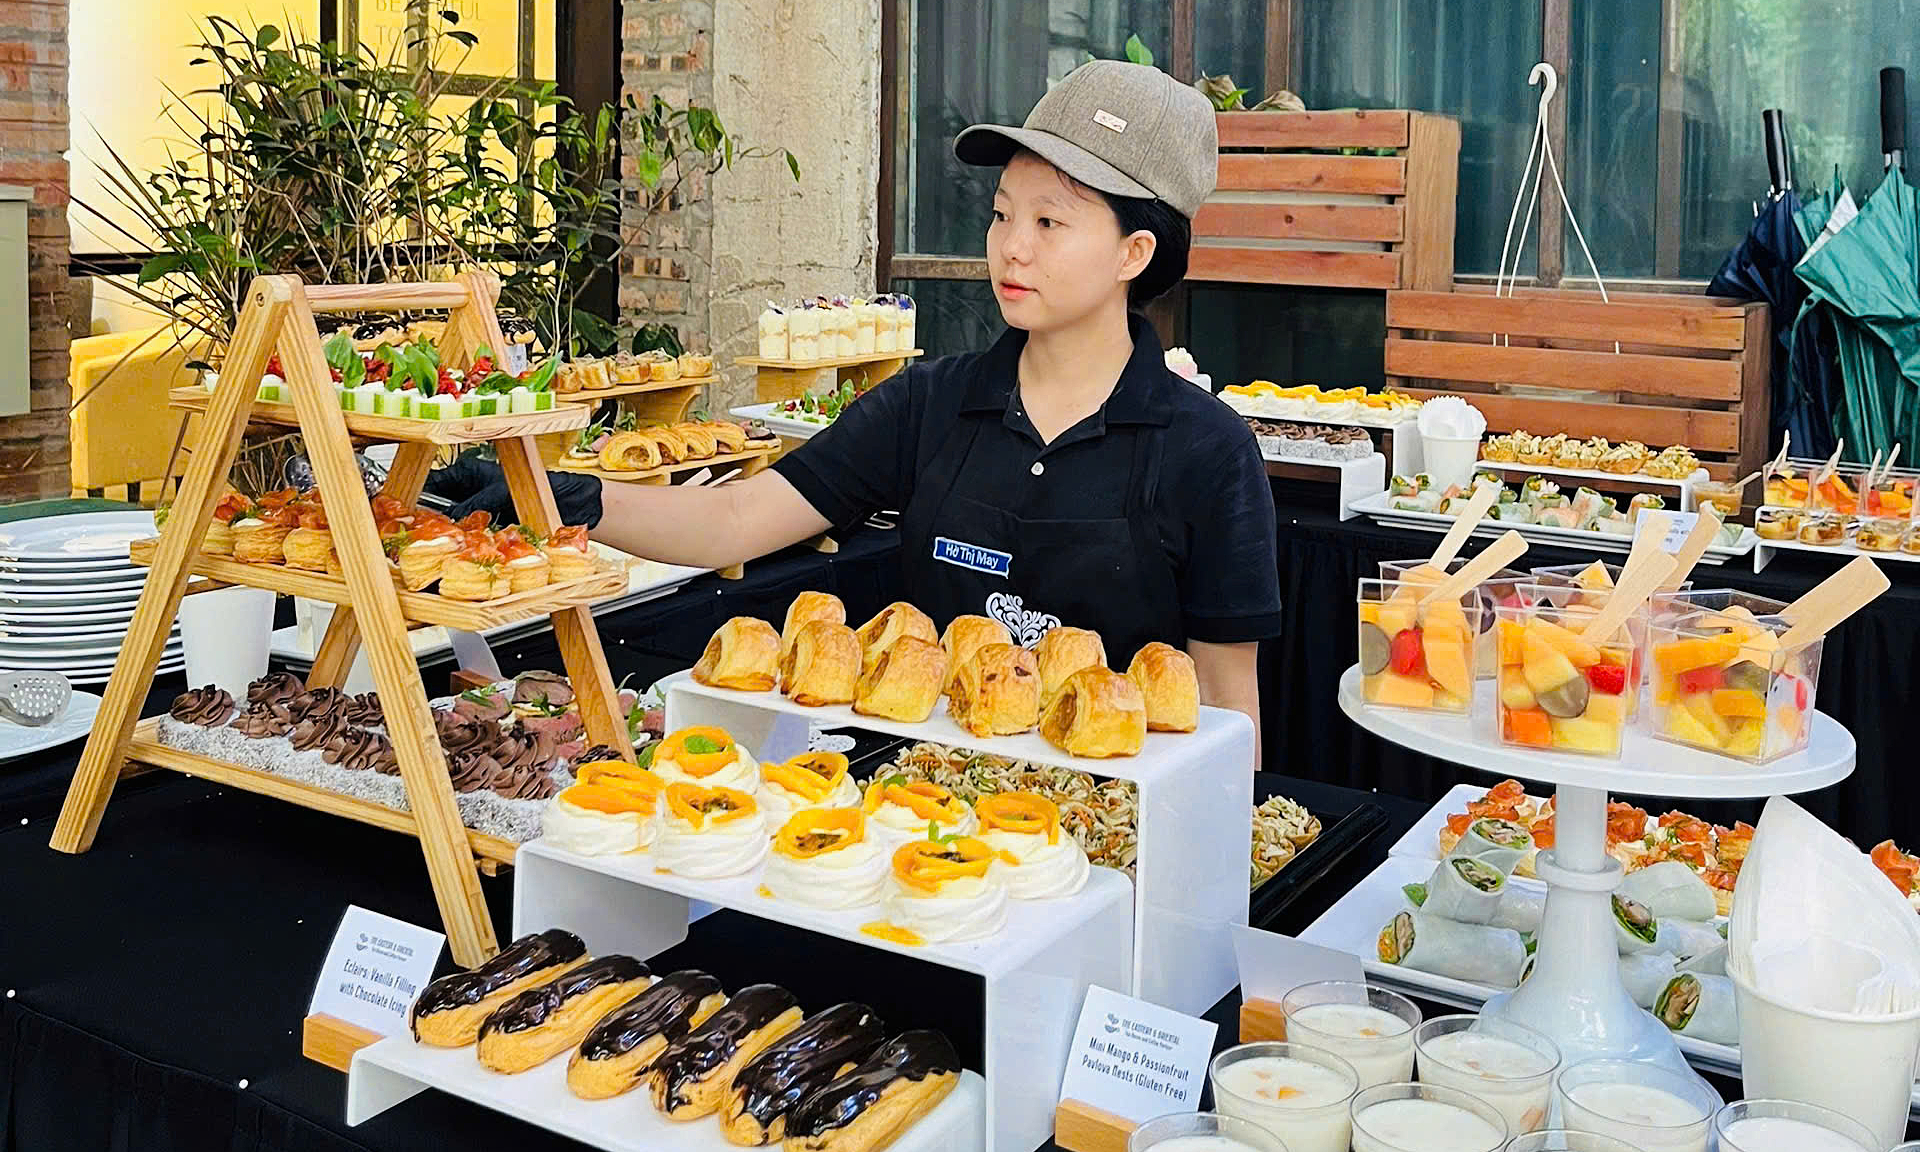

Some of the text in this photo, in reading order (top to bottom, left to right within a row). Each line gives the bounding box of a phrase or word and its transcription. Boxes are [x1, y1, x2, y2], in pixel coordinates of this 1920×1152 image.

[976, 550, 999, 569] May
[339, 981, 408, 1018] with Chocolate Icing
[370, 967, 394, 988] Vanilla
[393, 975, 417, 998] Filling
[1089, 1036, 1106, 1053] Mini
[1106, 1042, 1131, 1063] Mango
[1132, 1051, 1139, 1064] &
[1140, 1054, 1189, 1082] Passionfruit
[1082, 1054, 1111, 1074] Pavlova
[1135, 1074, 1164, 1094] (Gluten
[1164, 1082, 1188, 1102] Free)
